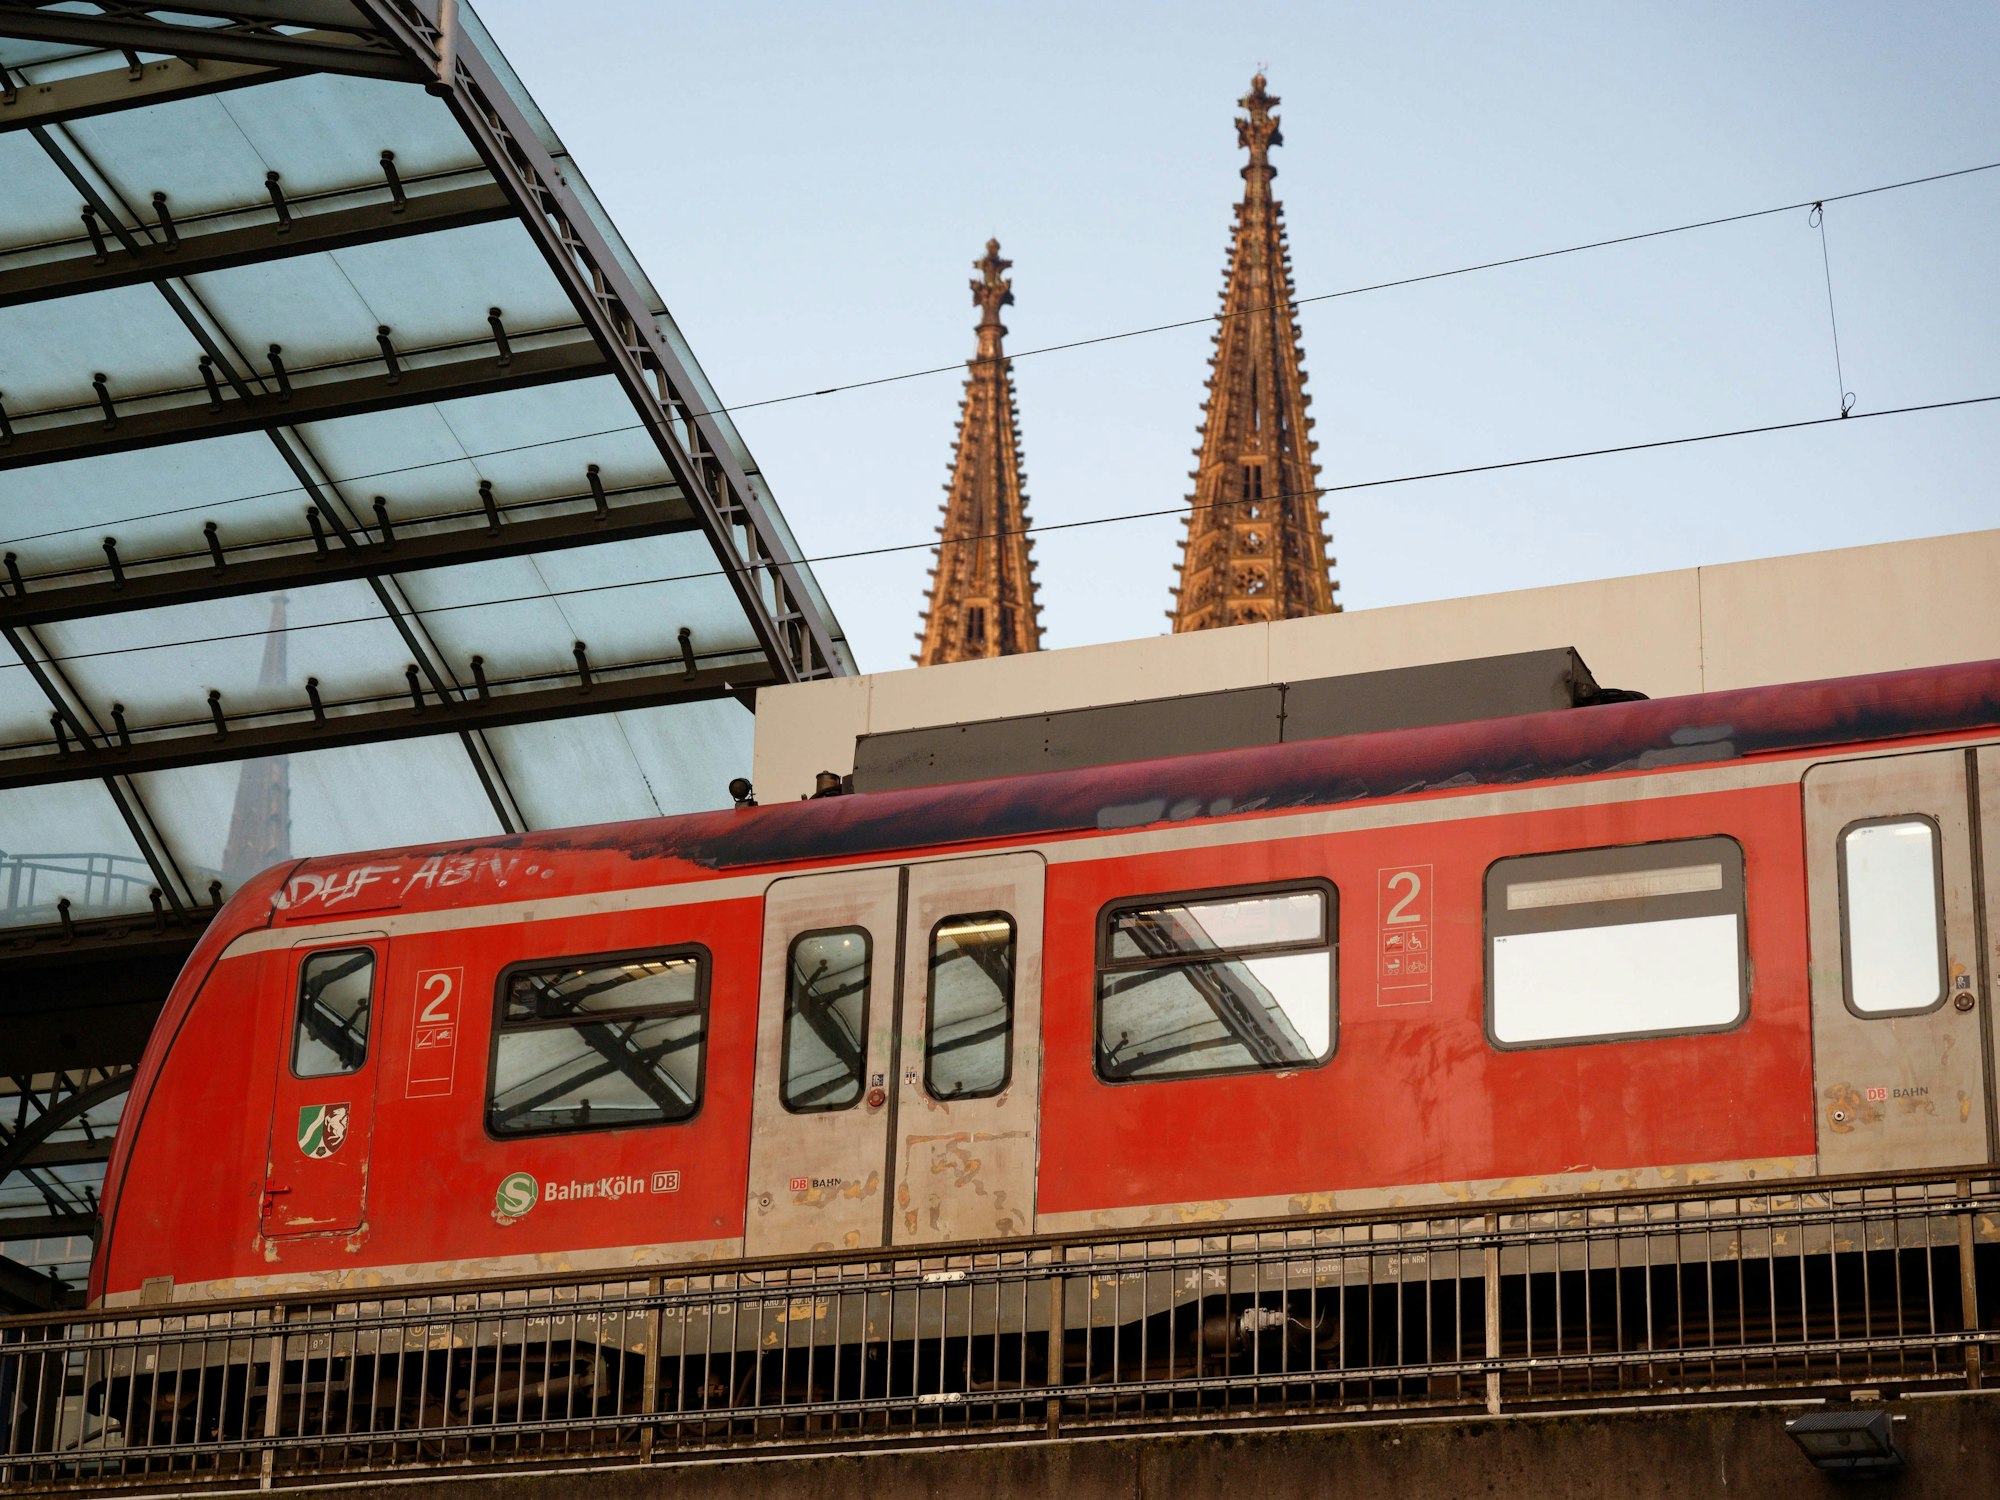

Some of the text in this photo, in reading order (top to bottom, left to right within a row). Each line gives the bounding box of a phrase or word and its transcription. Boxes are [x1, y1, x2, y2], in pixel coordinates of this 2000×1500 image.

[1387, 871, 1421, 925] 2
[420, 973, 453, 1023] 2
[1867, 1087, 1929, 1100] DB BAHN
[501, 1172, 678, 1214] S Bahn Köln DB
[791, 1178, 842, 1190] DB BAHN
